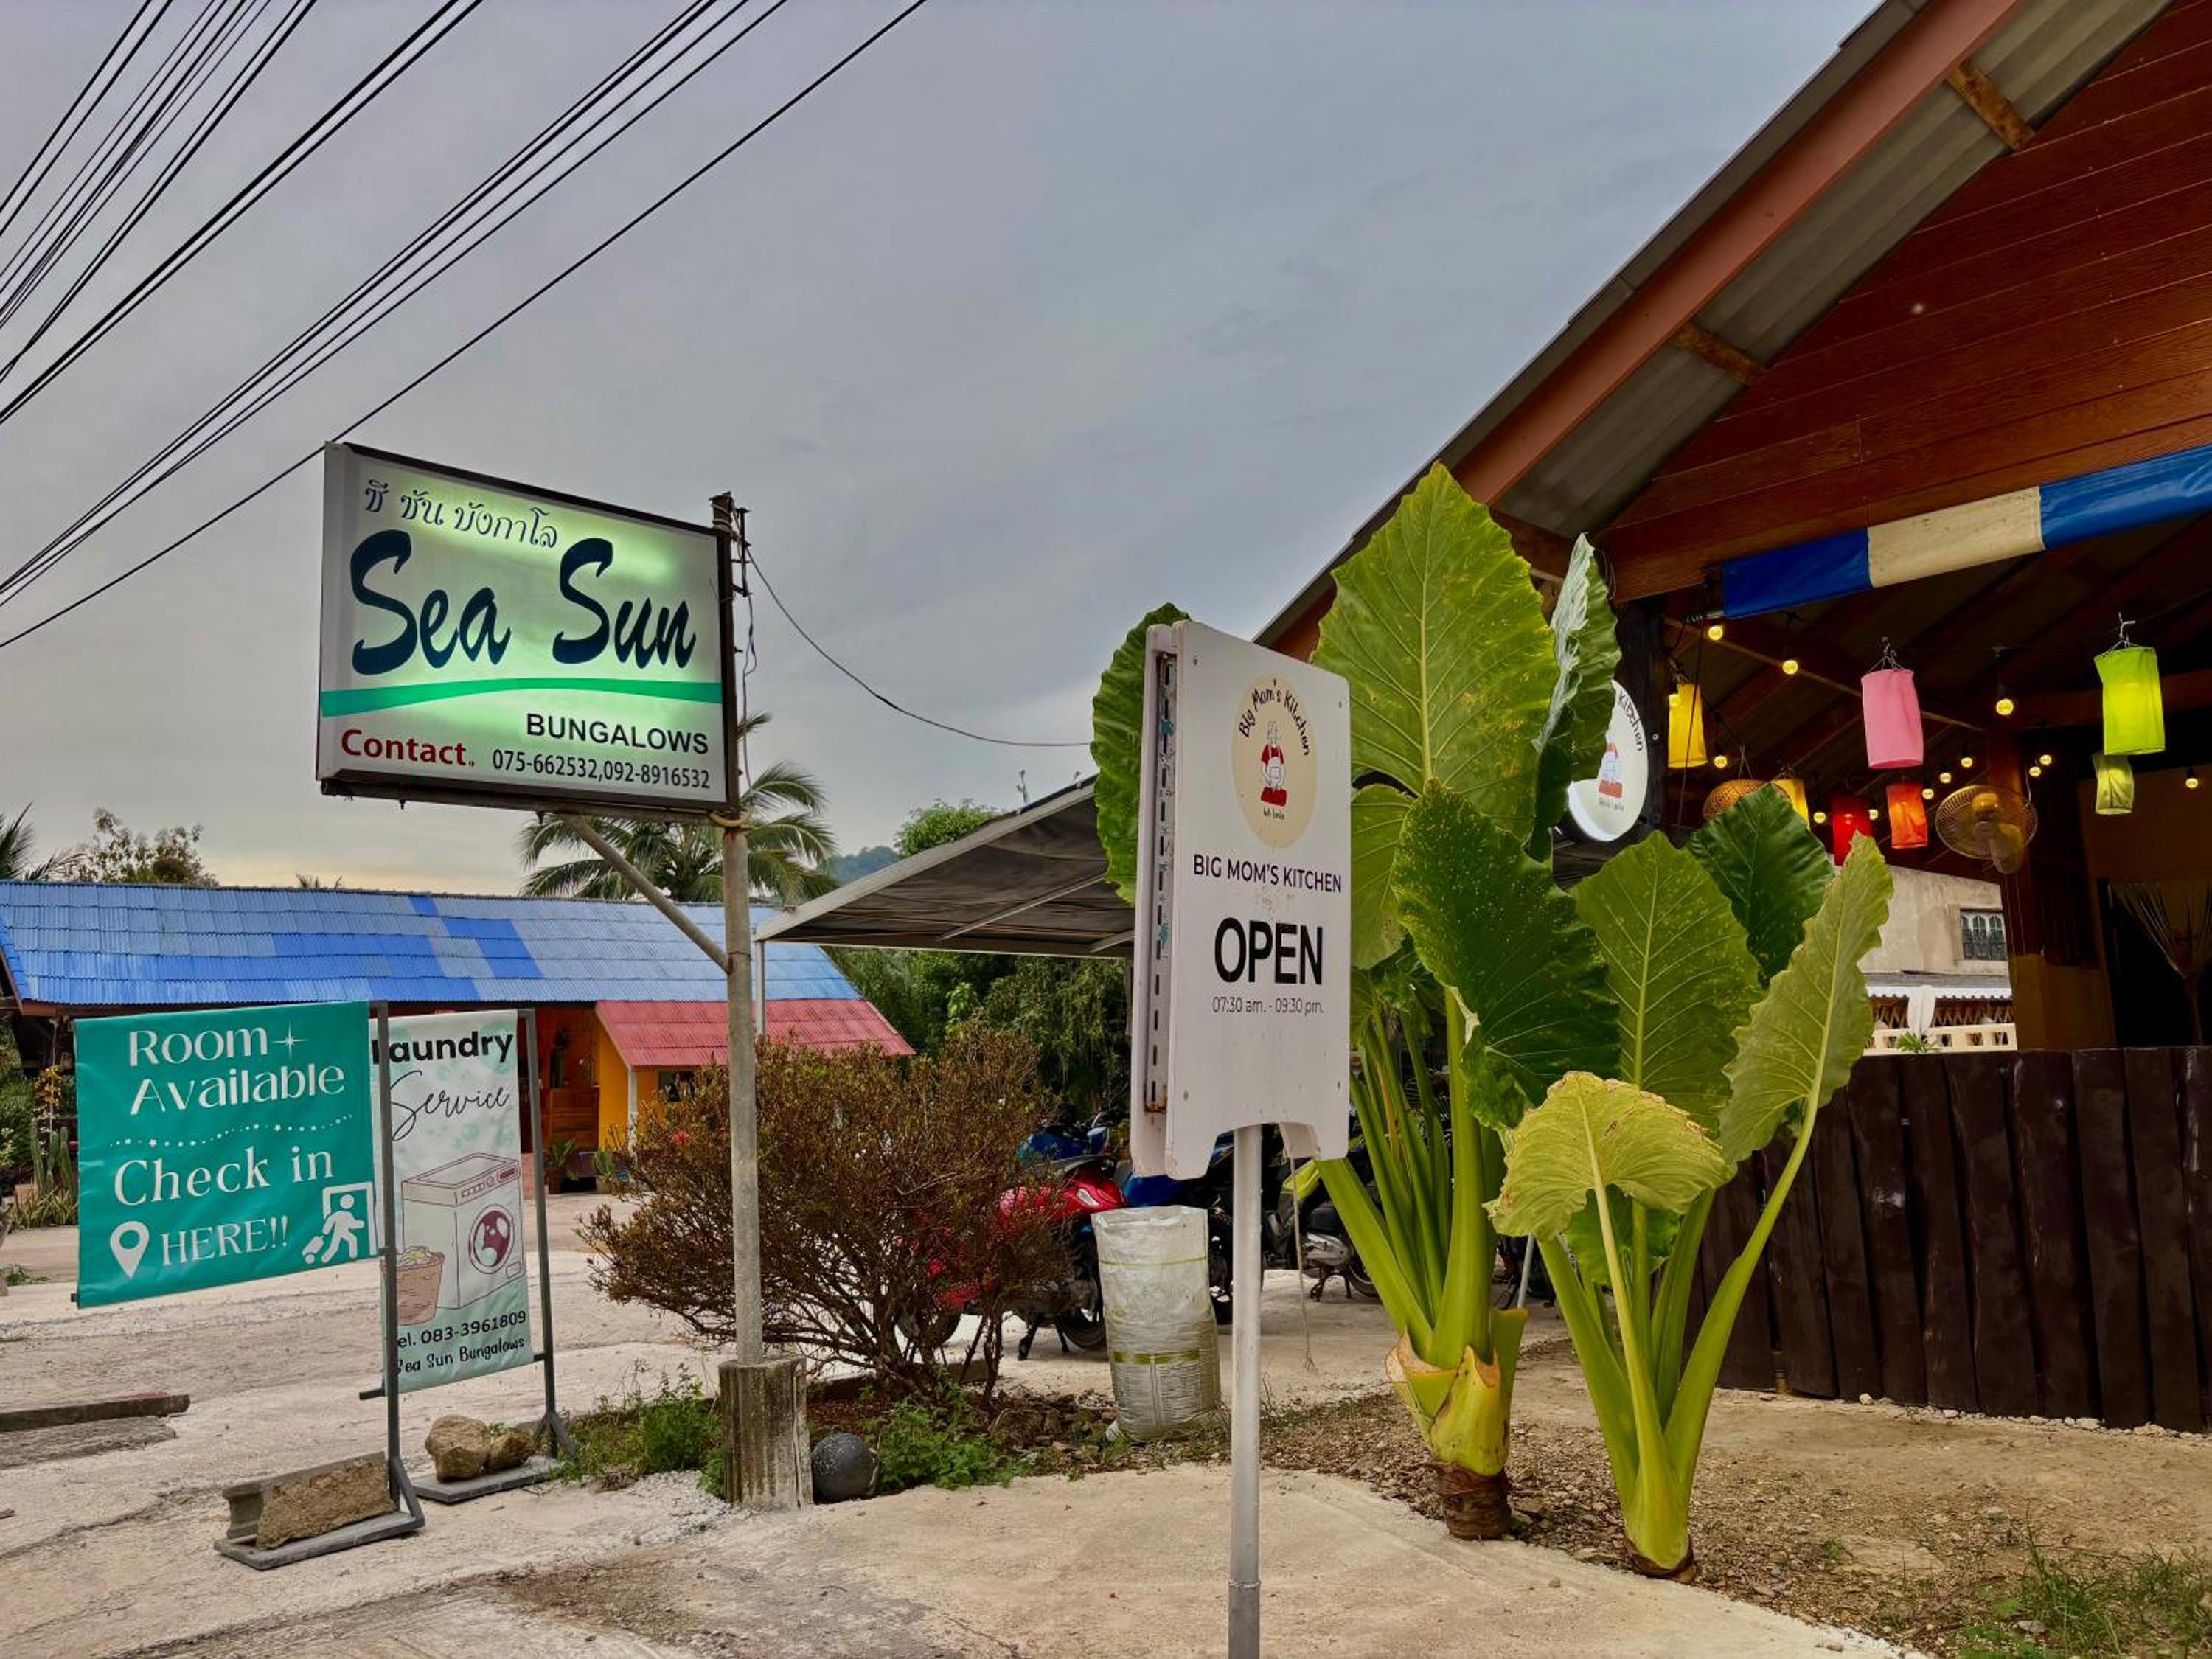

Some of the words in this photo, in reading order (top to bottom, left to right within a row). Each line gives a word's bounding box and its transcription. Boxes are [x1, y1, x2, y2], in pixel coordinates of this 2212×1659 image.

[350, 529, 511, 675] Sea
[552, 538, 696, 669] Sun
[526, 713, 709, 754] BUNGALOWS
[1238, 709, 1255, 738] Big
[1284, 690, 1310, 756] Kitchen
[1193, 854, 1222, 877] BIG
[1227, 859, 1279, 885] MOM'S
[1283, 866, 1342, 893] KITCHEN
[1214, 917, 1324, 985] OPEN
[1213, 996, 1243, 1012] 07:30
[1275, 998, 1302, 1013] 09:30
[128, 1027, 268, 1068] Room
[130, 1062, 344, 1116] Available
[390, 1070, 509, 1141] Service
[114, 1145, 271, 1206] Check
[291, 1146, 333, 1183] in
[160, 1214, 289, 1266] HERE!!
[397, 1333, 417, 1349] el.
[421, 1310, 526, 1344] 083-3961809
[426, 1353, 453, 1369] Sun
[459, 1337, 525, 1363] Bungalows
